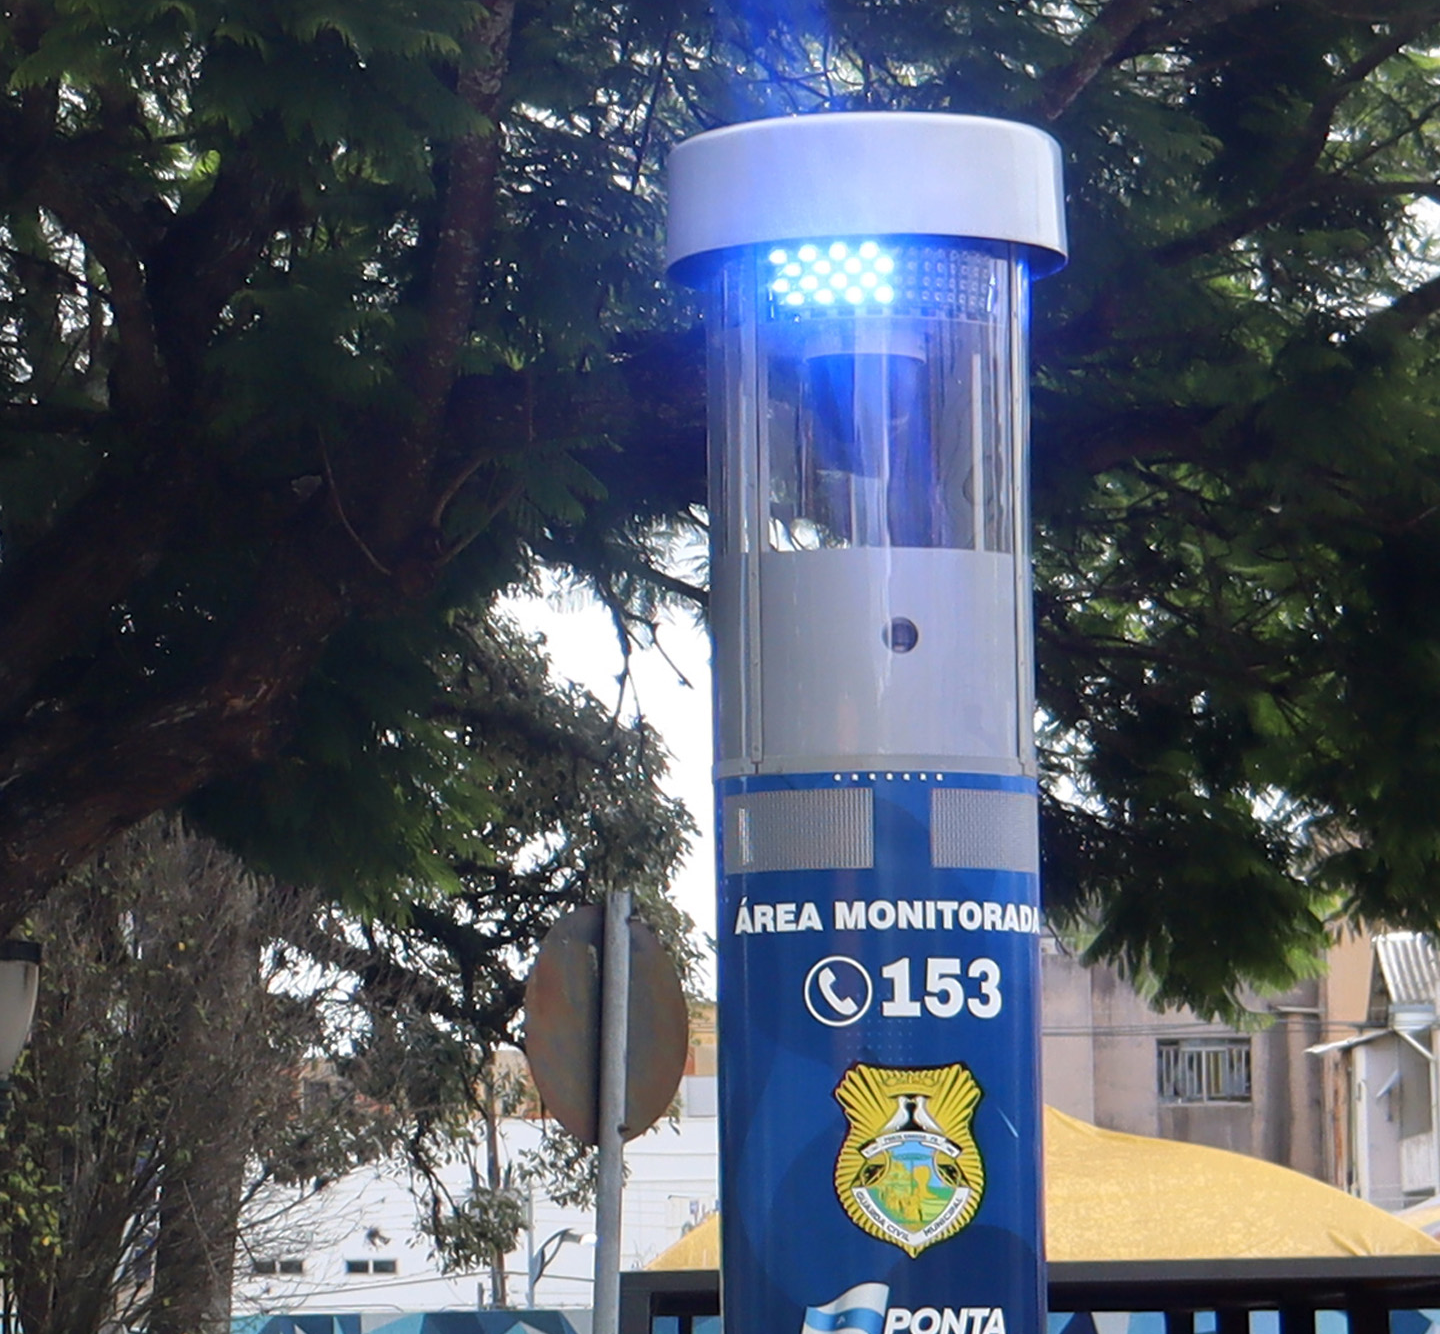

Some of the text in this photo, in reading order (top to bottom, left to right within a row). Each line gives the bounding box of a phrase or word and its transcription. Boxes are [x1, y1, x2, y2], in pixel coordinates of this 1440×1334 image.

[734, 897, 1040, 936] ÁREA MONITORADA
[881, 957, 1002, 1019] 153
[856, 1190, 964, 1242] GUARDA CIVIL MUNICIPAL
